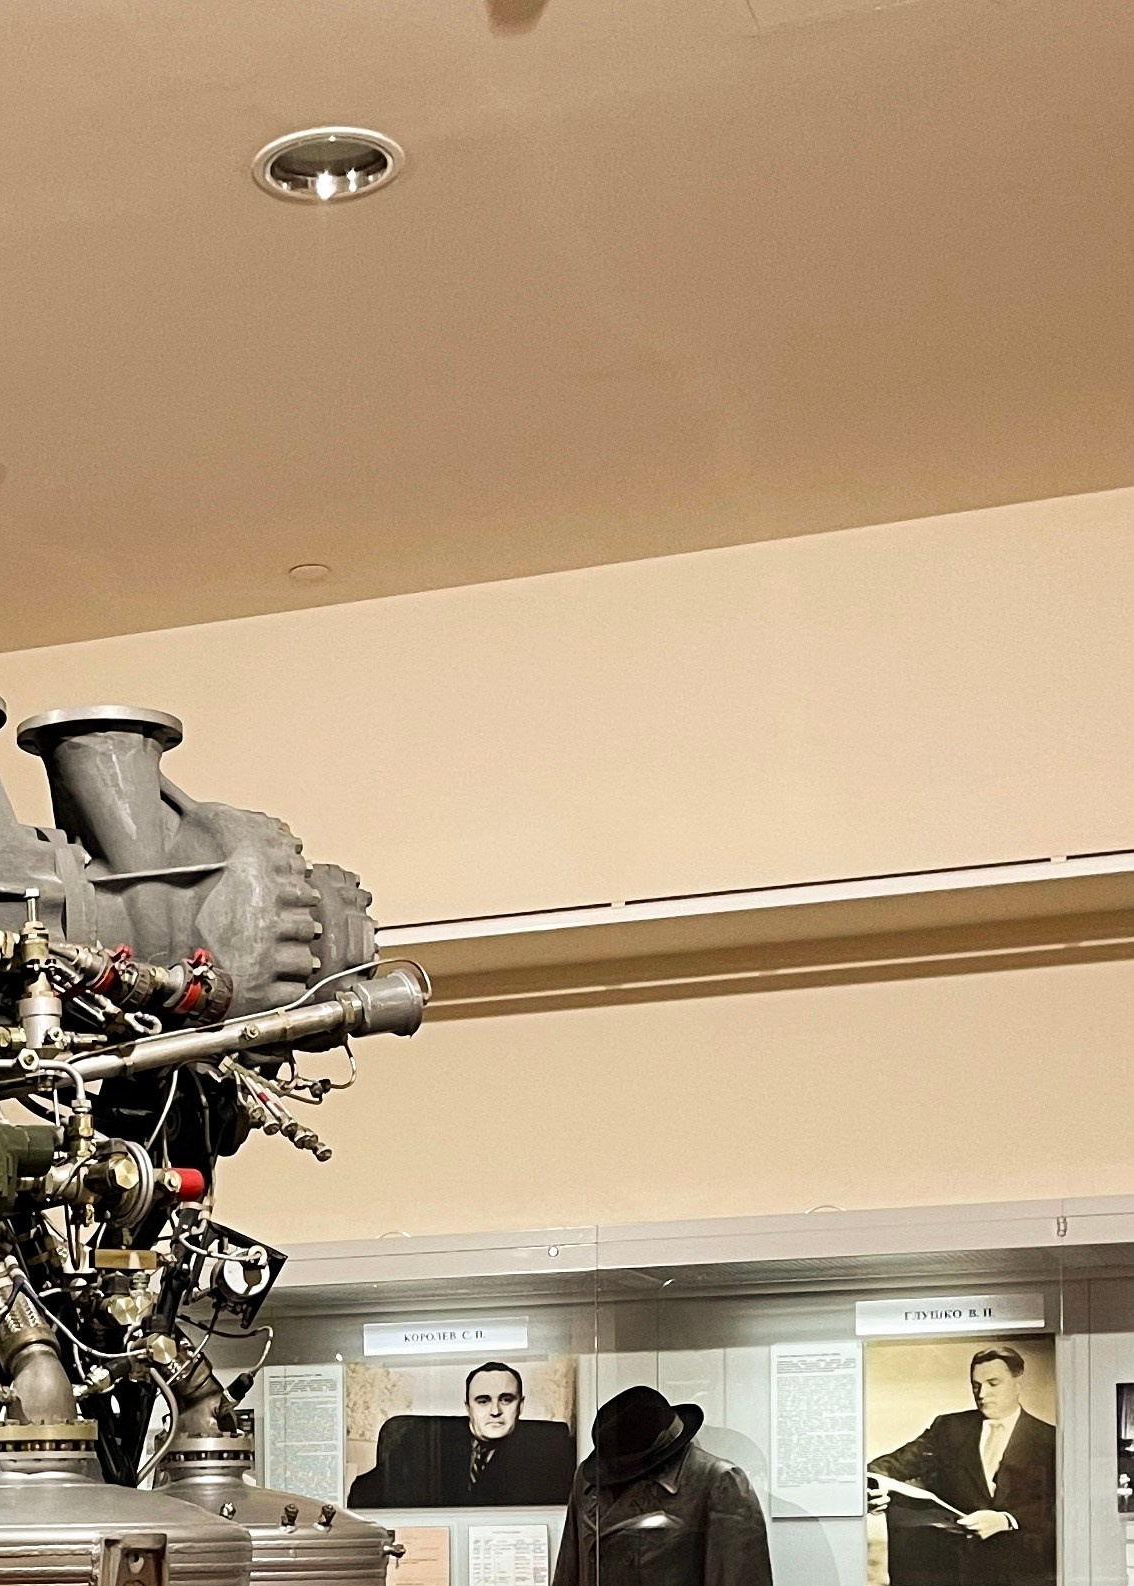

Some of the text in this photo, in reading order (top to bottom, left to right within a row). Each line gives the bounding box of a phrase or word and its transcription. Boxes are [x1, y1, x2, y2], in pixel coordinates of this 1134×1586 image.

[904, 1309, 962, 1321] ГЛУШКО
[968, 1308, 980, 1318] В.
[404, 1331, 457, 1343] КОРОЛЕВ
